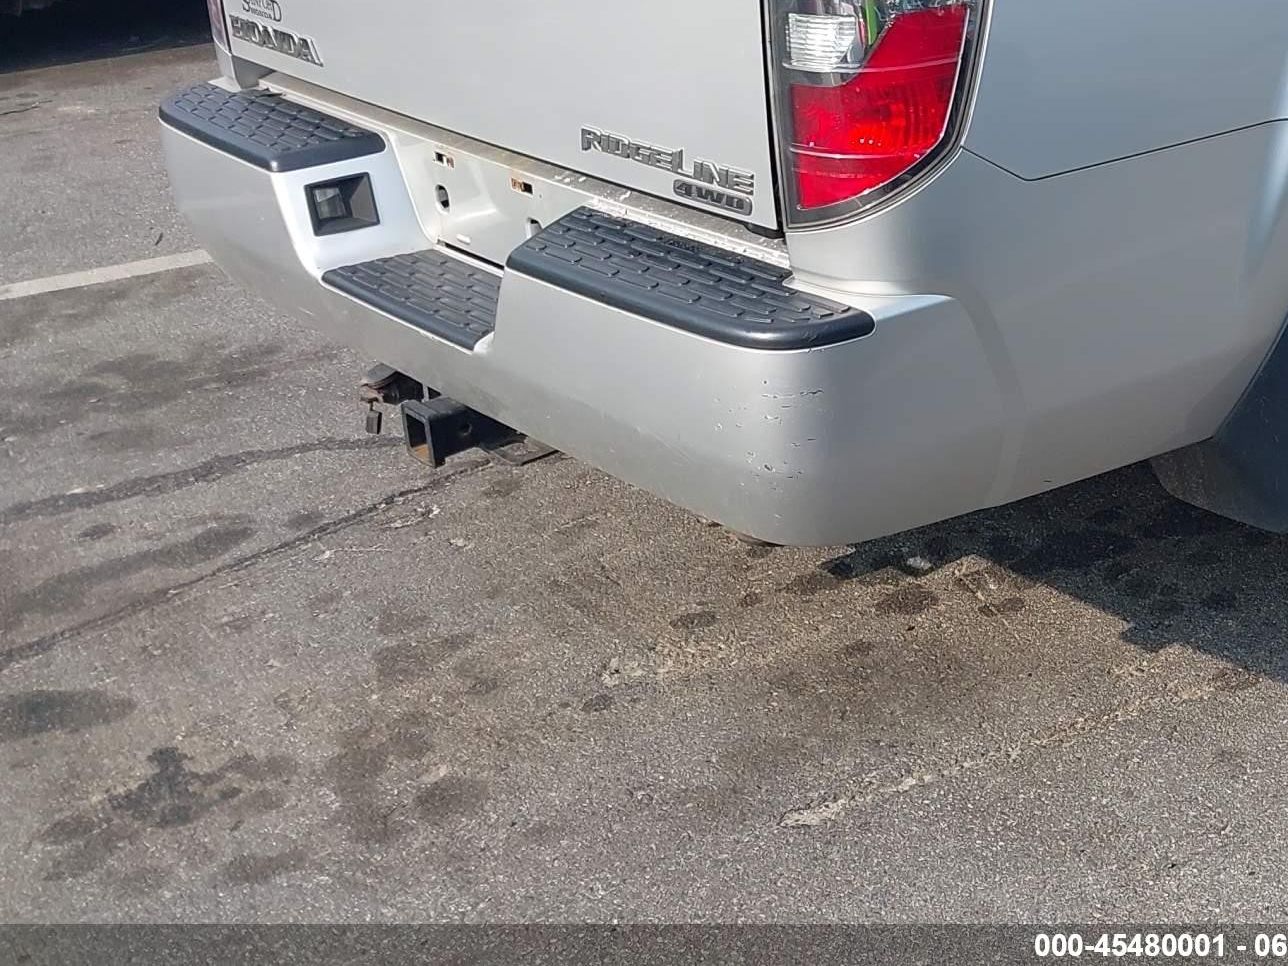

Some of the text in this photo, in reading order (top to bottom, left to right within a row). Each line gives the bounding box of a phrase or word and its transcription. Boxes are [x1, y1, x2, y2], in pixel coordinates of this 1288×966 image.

[229, 14, 324, 67] HONDA
[580, 123, 756, 197] RIDGELINE
[673, 180, 752, 215] 4WD
